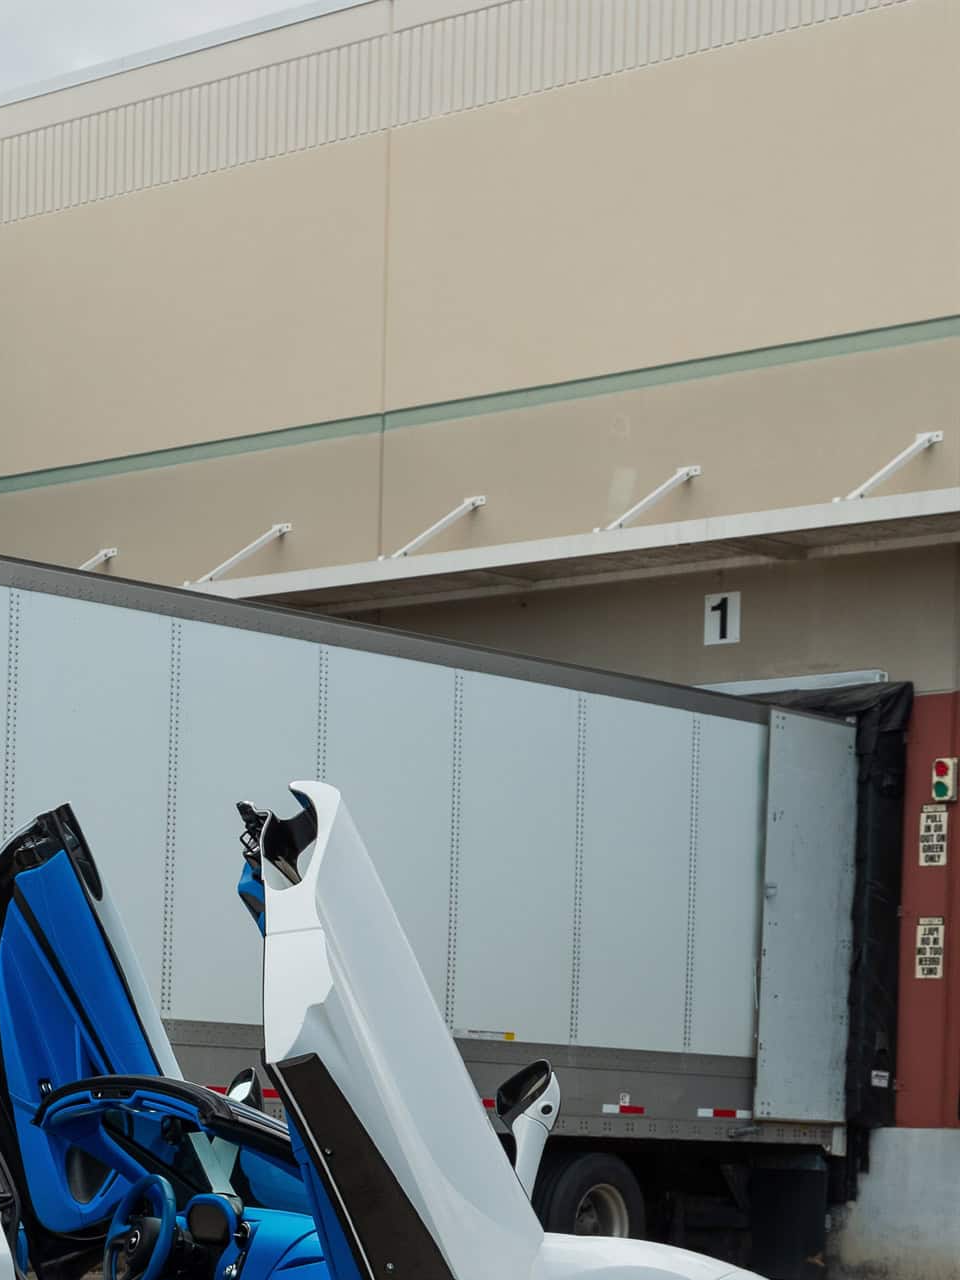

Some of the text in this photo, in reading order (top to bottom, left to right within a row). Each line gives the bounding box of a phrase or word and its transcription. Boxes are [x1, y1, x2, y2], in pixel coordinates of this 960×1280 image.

[711, 597, 728, 640] 1
[925, 814, 941, 823] PULL
[924, 824, 943, 833] IN OR
[920, 834, 945, 843] OUT ON
[922, 844, 944, 853] GREEN
[924, 854, 941, 863] ONLY
